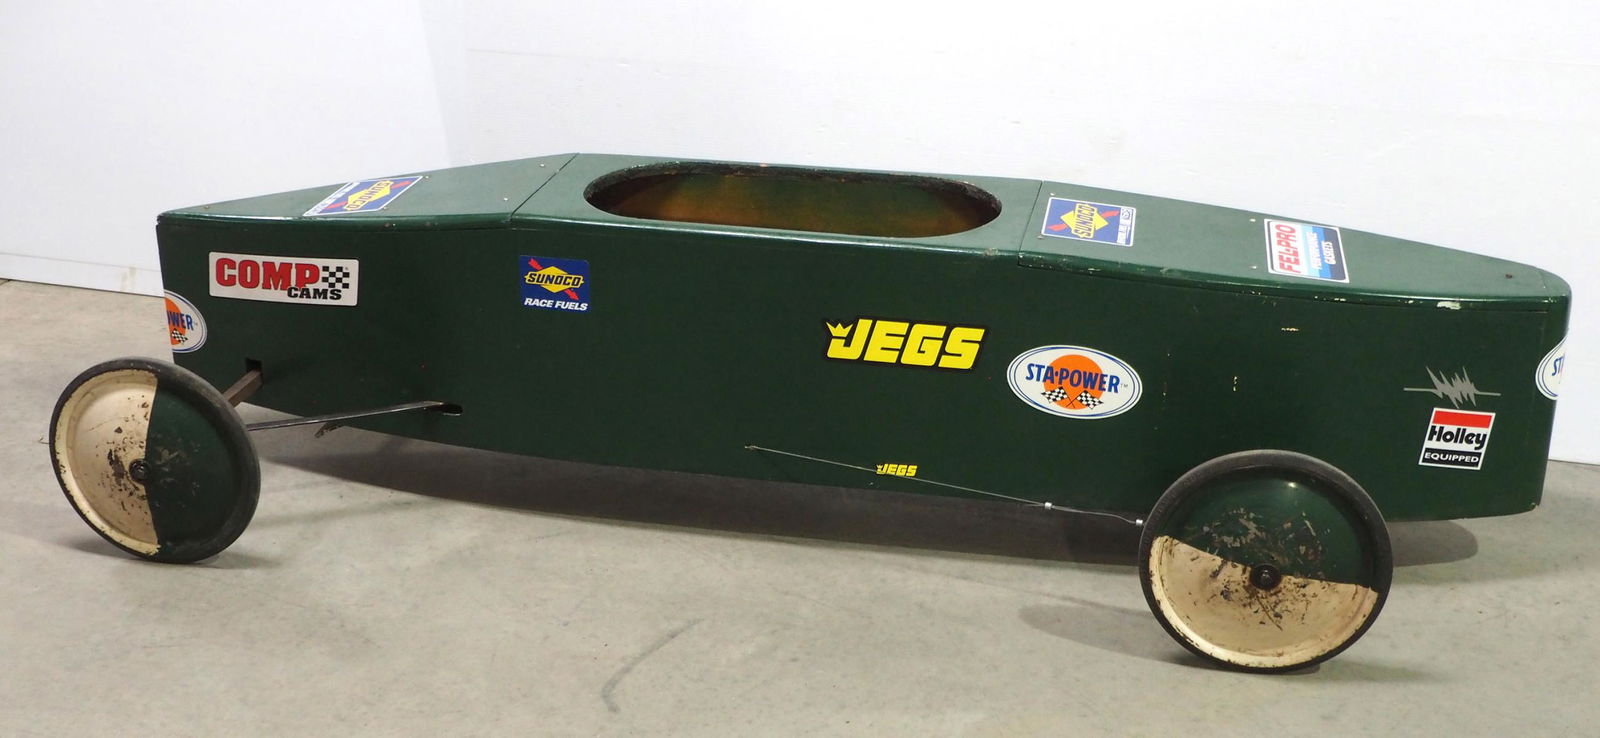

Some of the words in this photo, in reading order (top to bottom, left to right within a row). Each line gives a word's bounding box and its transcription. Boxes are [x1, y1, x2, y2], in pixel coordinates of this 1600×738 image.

[344, 181, 393, 210] SUNOCO
[1073, 204, 1096, 238] SUNOCO
[215, 258, 320, 291] COMP
[526, 272, 582, 288] SUNOCO
[287, 287, 343, 300] CAMS
[524, 297, 554, 308] RACE
[554, 300, 588, 311] FUELS
[826, 318, 985, 370] JEGS
[1427, 425, 1487, 451] Holley
[1424, 452, 1479, 463] EQUIPPED
[876, 463, 918, 477] JEGS
